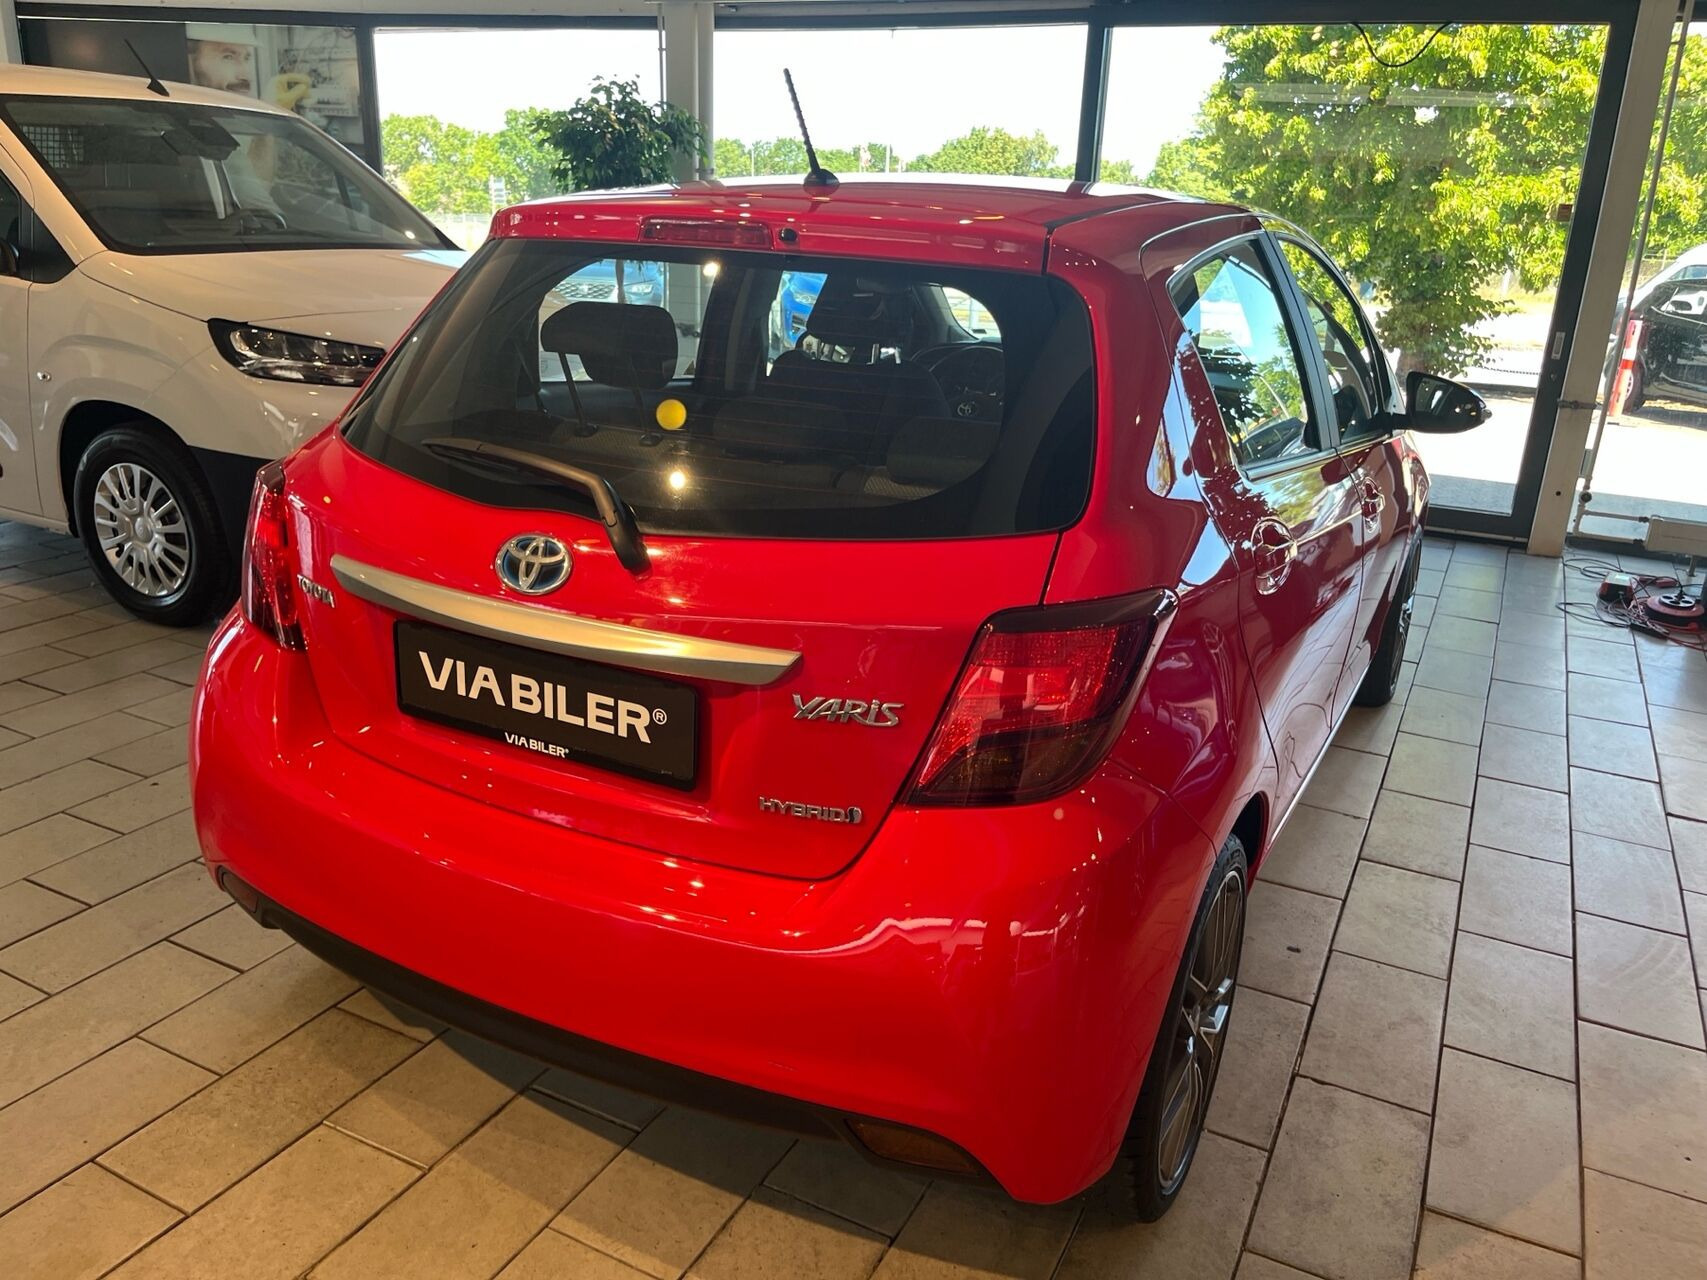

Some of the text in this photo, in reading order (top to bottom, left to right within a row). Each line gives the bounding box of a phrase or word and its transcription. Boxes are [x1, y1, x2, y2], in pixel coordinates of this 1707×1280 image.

[296, 573, 335, 609] TOYOTA
[418, 650, 506, 707] VIA
[504, 731, 529, 749] VIA
[759, 796, 842, 822] HYBRID
